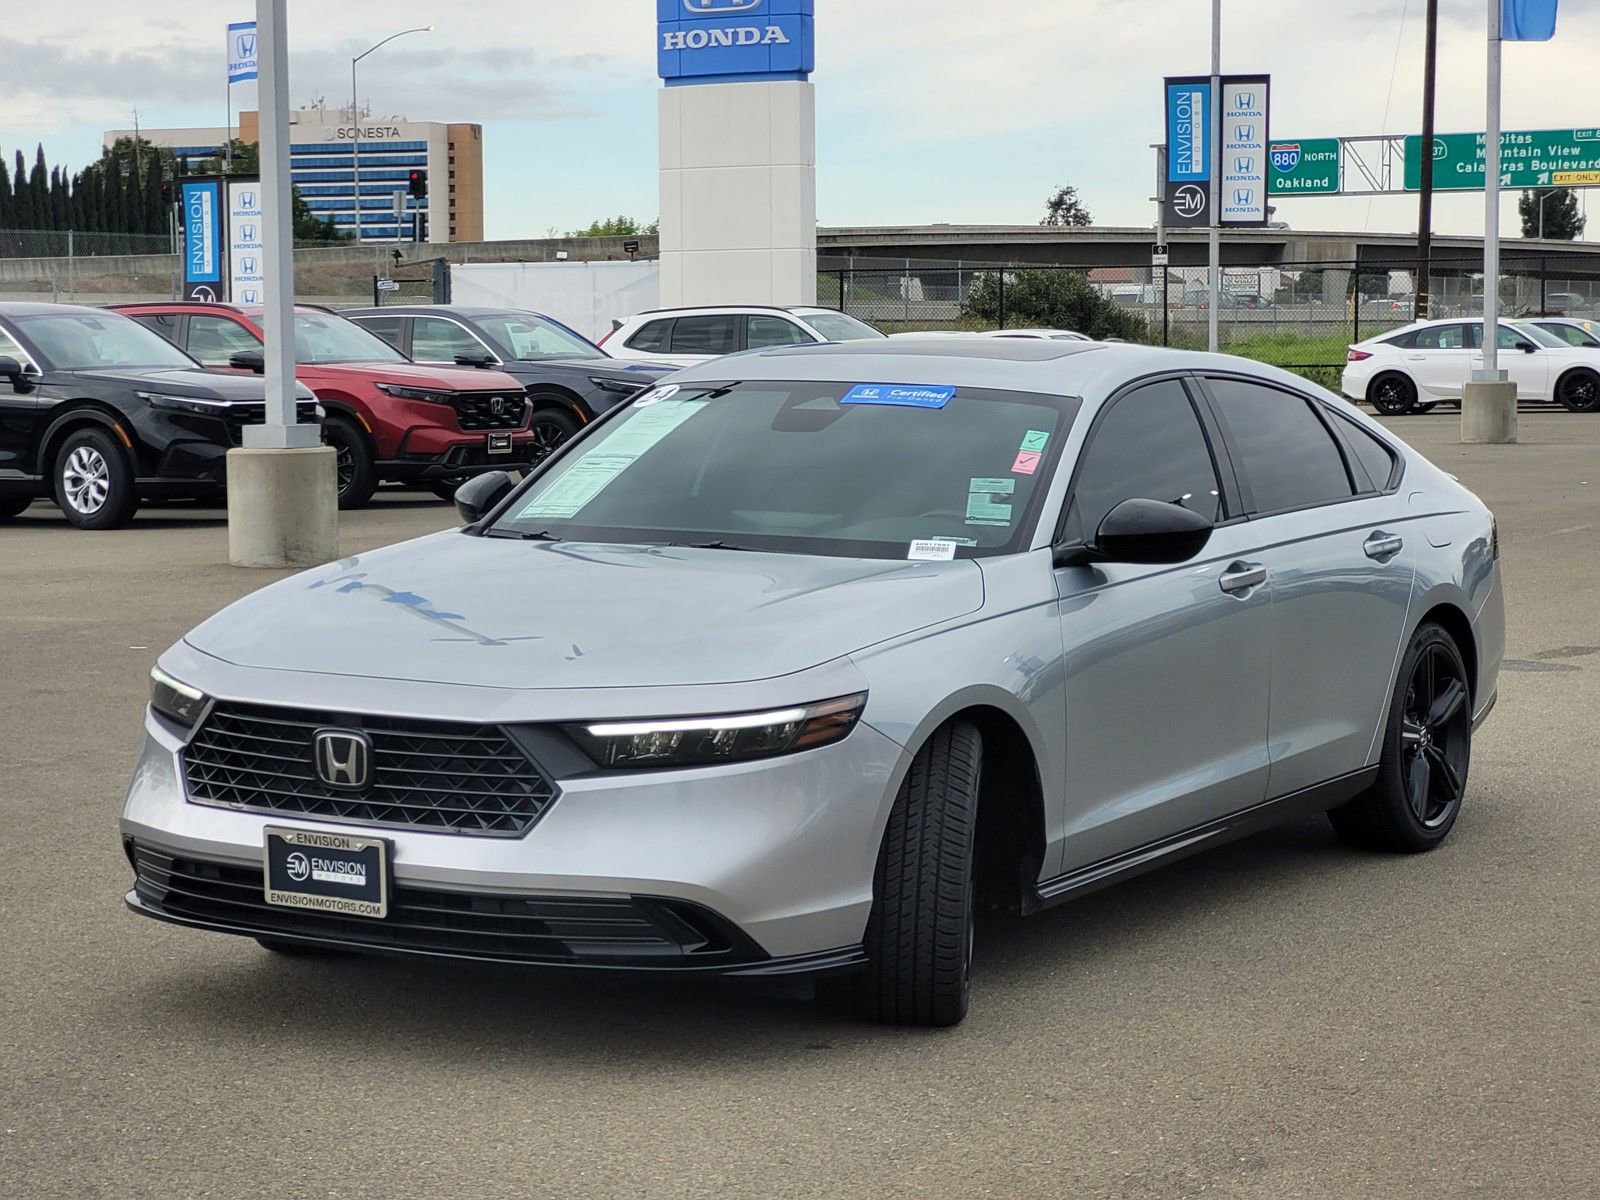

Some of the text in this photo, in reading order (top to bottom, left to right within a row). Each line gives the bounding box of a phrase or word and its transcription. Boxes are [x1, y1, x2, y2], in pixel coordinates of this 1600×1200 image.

[663, 26, 790, 50] HONDA
[337, 127, 401, 139] SONESTA
[1177, 92, 1191, 174] ENVISION
[1476, 133, 1532, 145] Mpitas
[1274, 152, 1337, 166] 880 NORTH
[1476, 145, 1580, 159] Mntain View
[1456, 161, 1524, 173] Calaras
[1276, 177, 1329, 188] Oakland
[1553, 173, 1599, 182] EXIT ONLY
[189, 191, 204, 274] ENVISION
[890, 389, 948, 399] Certified
[296, 833, 350, 848] ENVISION
[311, 858, 366, 876] ENVISION
[270, 892, 381, 915] ENVISIONMOTORS.COM
